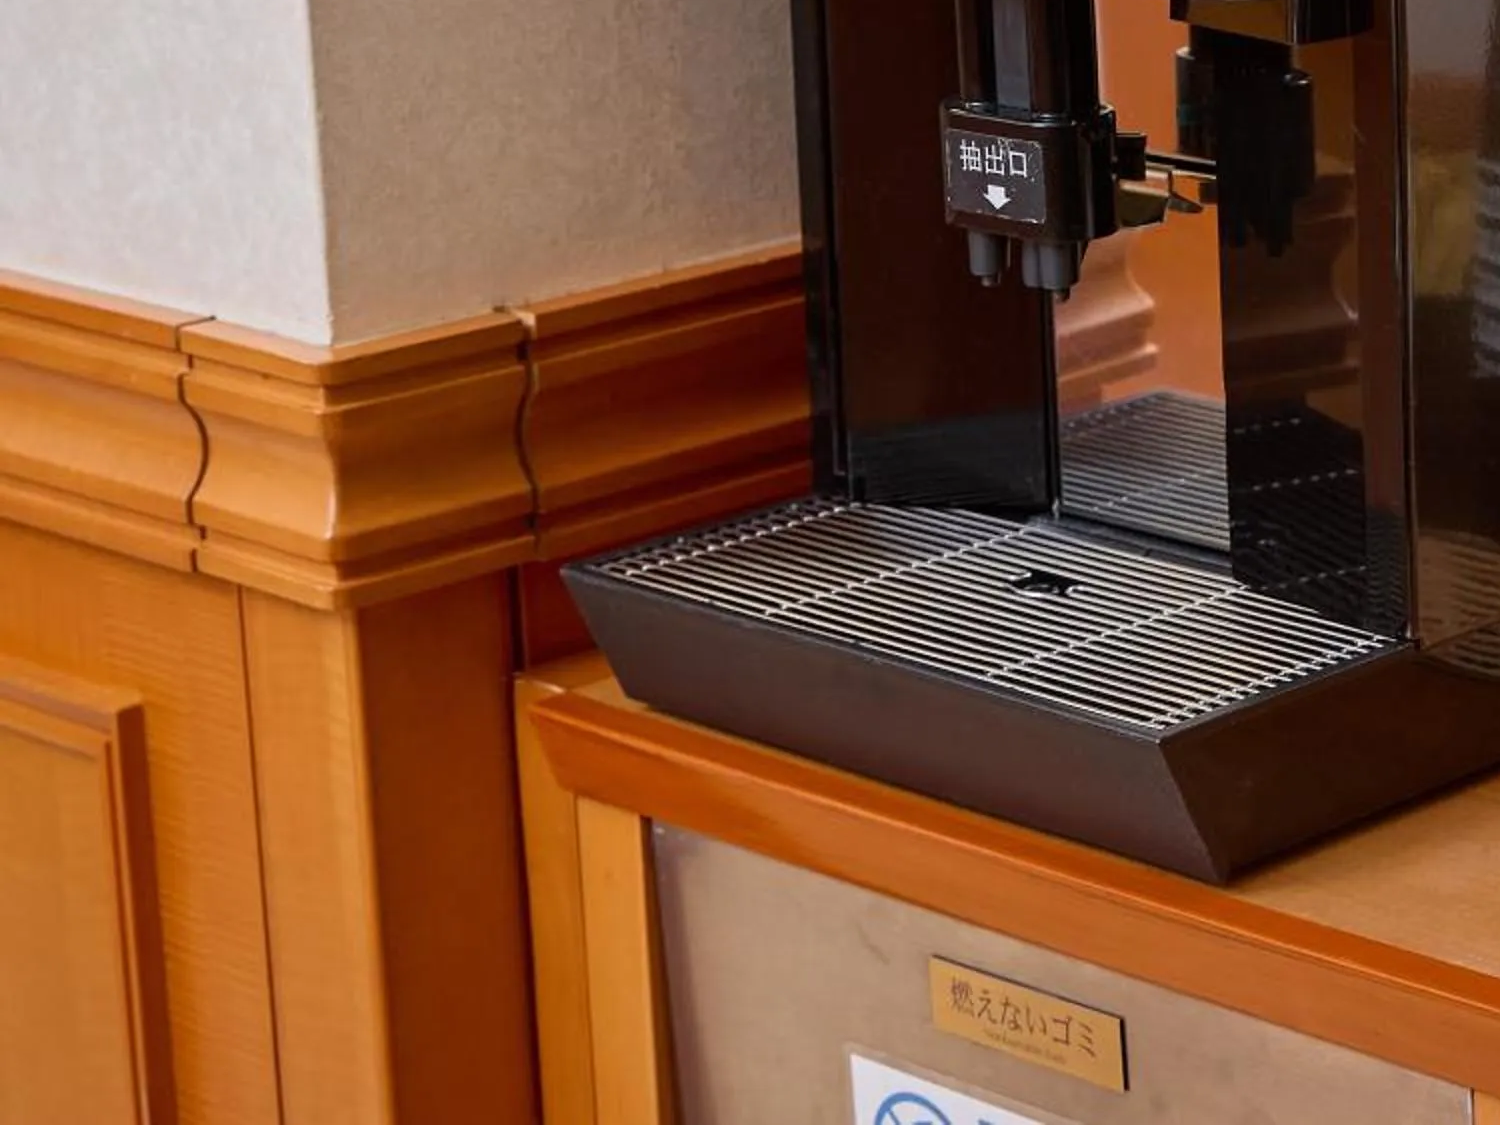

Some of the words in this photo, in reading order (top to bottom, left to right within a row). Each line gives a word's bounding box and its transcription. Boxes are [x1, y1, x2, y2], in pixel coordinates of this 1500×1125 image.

[959, 138, 1028, 178] 抽出口
[949, 975, 1097, 1059] 燃えないゴミ
